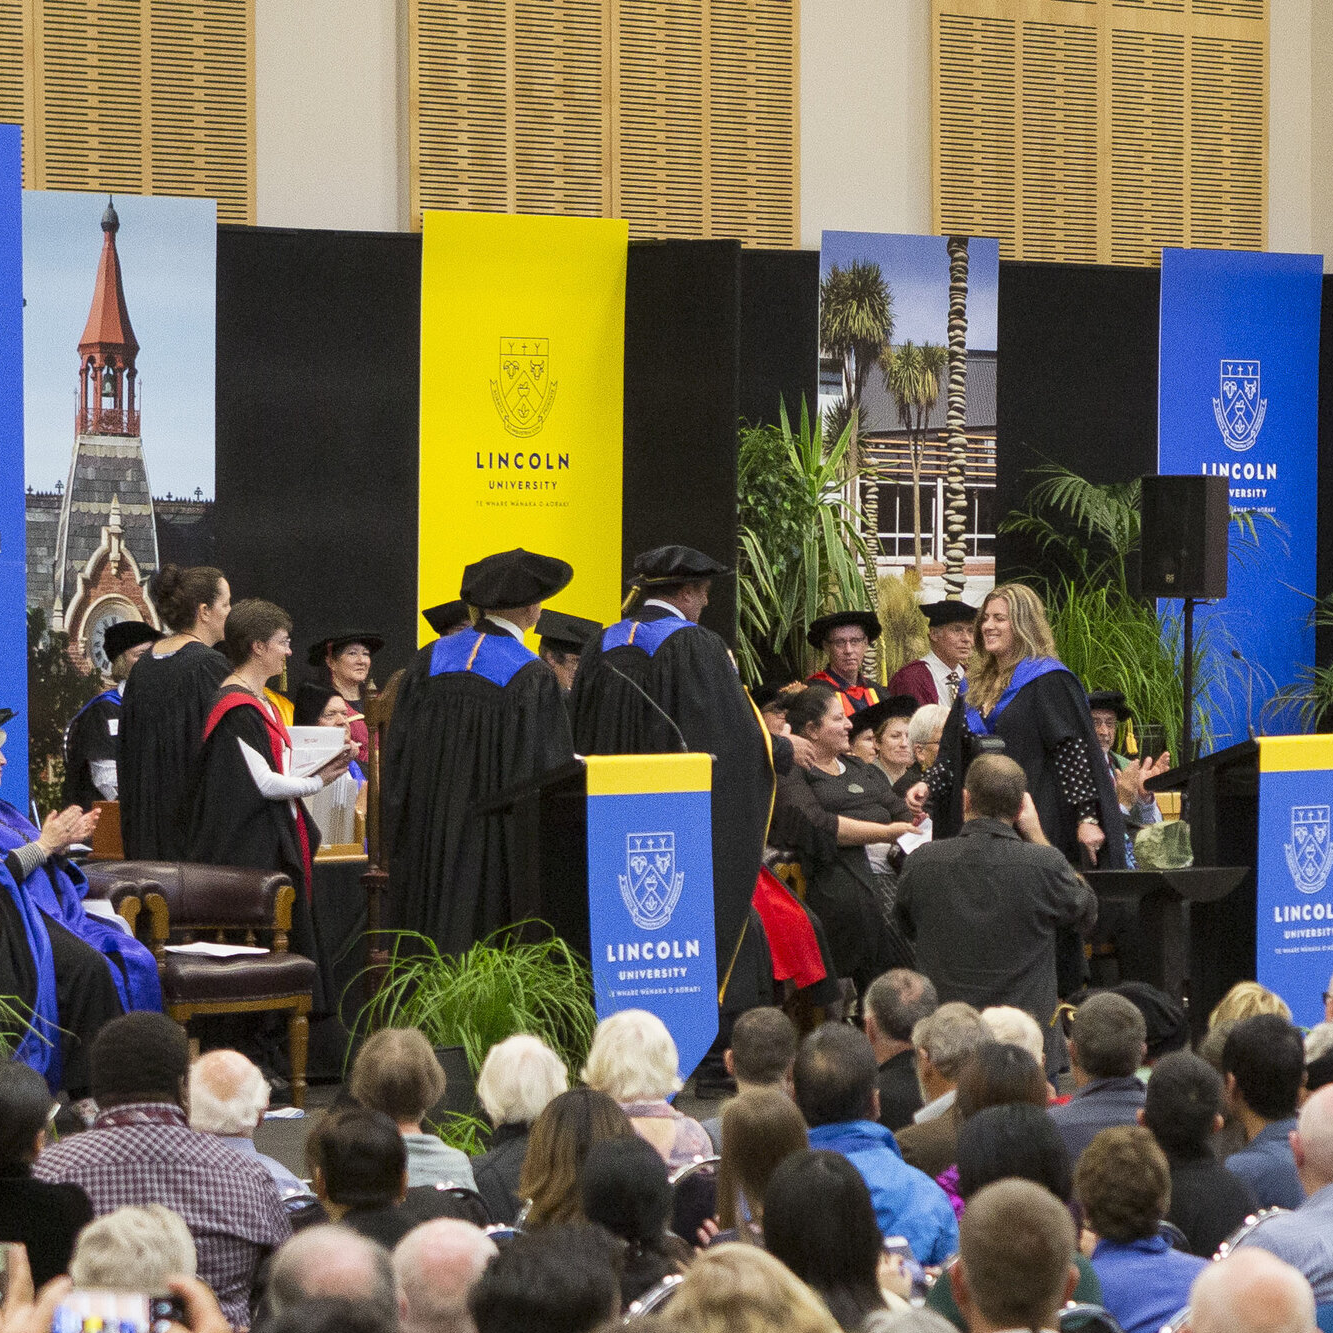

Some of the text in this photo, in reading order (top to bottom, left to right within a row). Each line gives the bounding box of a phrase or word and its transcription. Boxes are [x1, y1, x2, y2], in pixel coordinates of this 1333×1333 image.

[476, 452, 570, 470] LINCOLN
[1202, 463, 1277, 480] LINCOLN
[489, 480, 558, 490] UNIVERSITY
[1229, 488, 1267, 498] VERSITY
[606, 940, 700, 963] LINCOLN
[619, 967, 688, 981] UNIVERSITY
